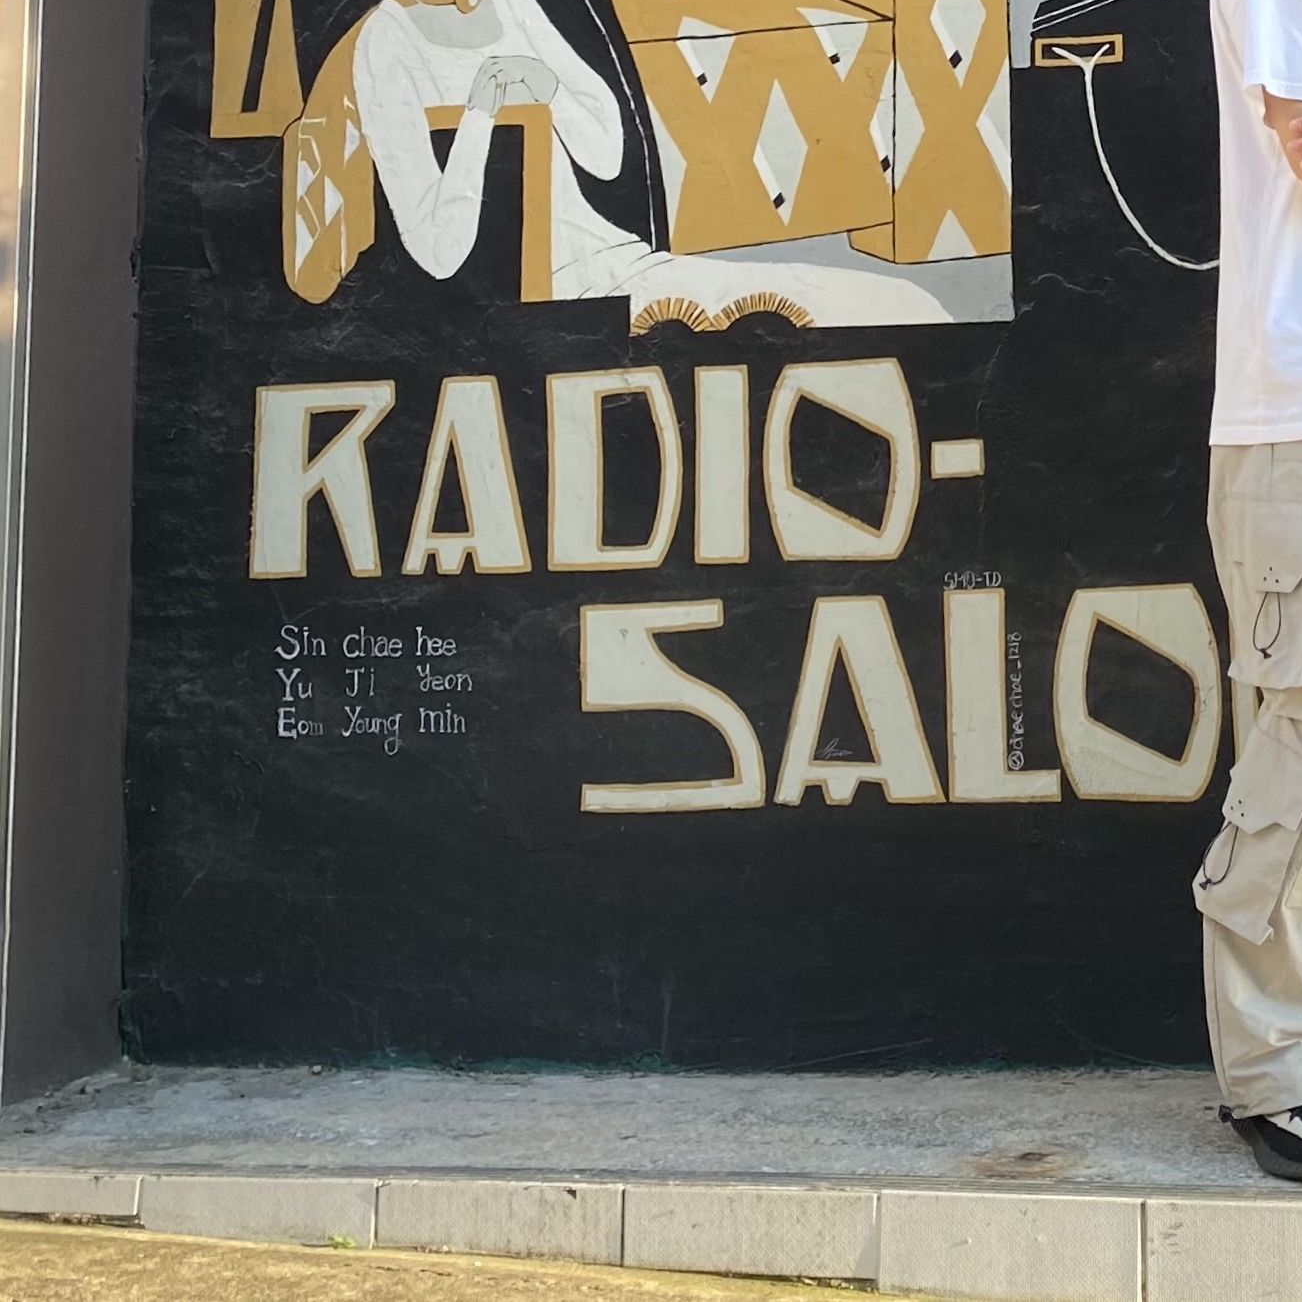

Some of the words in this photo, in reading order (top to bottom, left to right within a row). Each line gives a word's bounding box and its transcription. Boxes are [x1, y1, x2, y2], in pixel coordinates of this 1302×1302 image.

[249, 357, 985, 579] RADIO-
[274, 624, 327, 660] Sin
[415, 626, 458, 657] hee
[275, 667, 313, 702] Yu
[345, 667, 375, 698] Ji
[579, 580, 1260, 813] SALO
[277, 706, 324, 740] Eom
